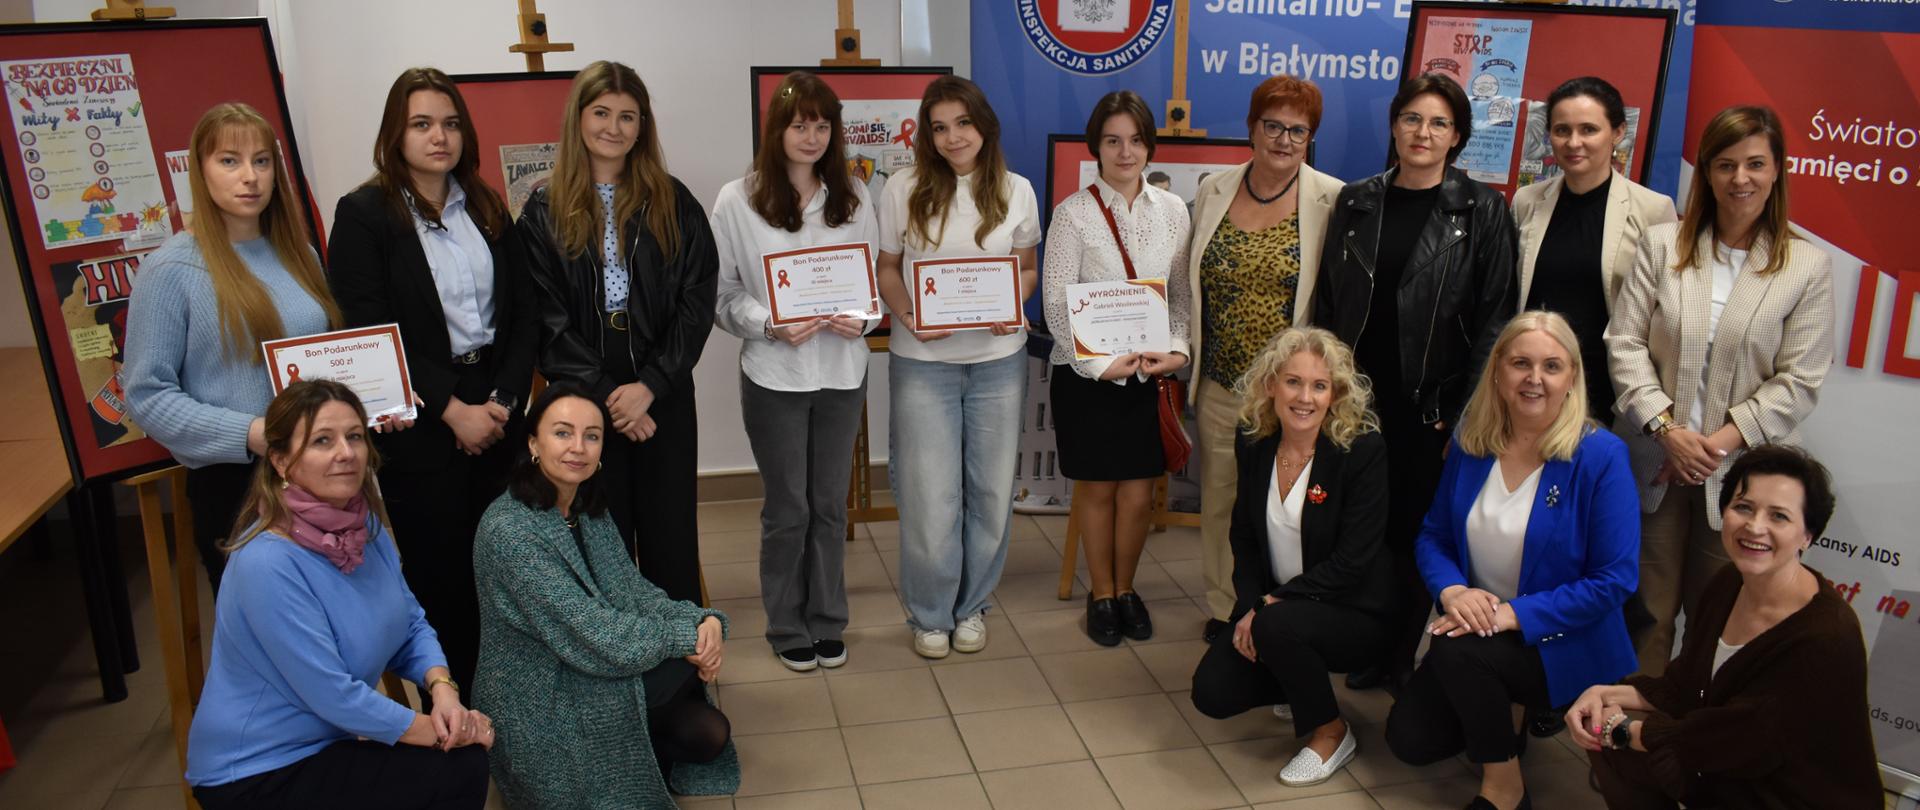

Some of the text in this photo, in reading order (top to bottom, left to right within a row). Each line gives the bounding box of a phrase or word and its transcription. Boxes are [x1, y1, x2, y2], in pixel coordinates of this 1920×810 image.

[1020, 0, 1169, 71] INSPEKCJA SANITARNA
[9, 58, 123, 82] BEZPIECZNI
[1201, 42, 1403, 81] w Białymsto
[23, 79, 51, 98] NA
[52, 77, 77, 96] CO
[1809, 109, 1920, 149] Świato
[167, 154, 189, 173] WI
[507, 162, 548, 185] ZAWALCZ
[1787, 154, 1882, 184] amięci
[1889, 166, 1908, 185] o
[808, 254, 854, 264] Podarunkowy
[956, 266, 1002, 274] Podarunkowy
[1089, 287, 1147, 299] WYRÓŻNIENIE
[305, 341, 380, 358] Bon Podarunkowy
[330, 357, 354, 367] 500 zł
[1812, 537, 1901, 567] ansy AIDS
[1877, 595, 1910, 619] na
